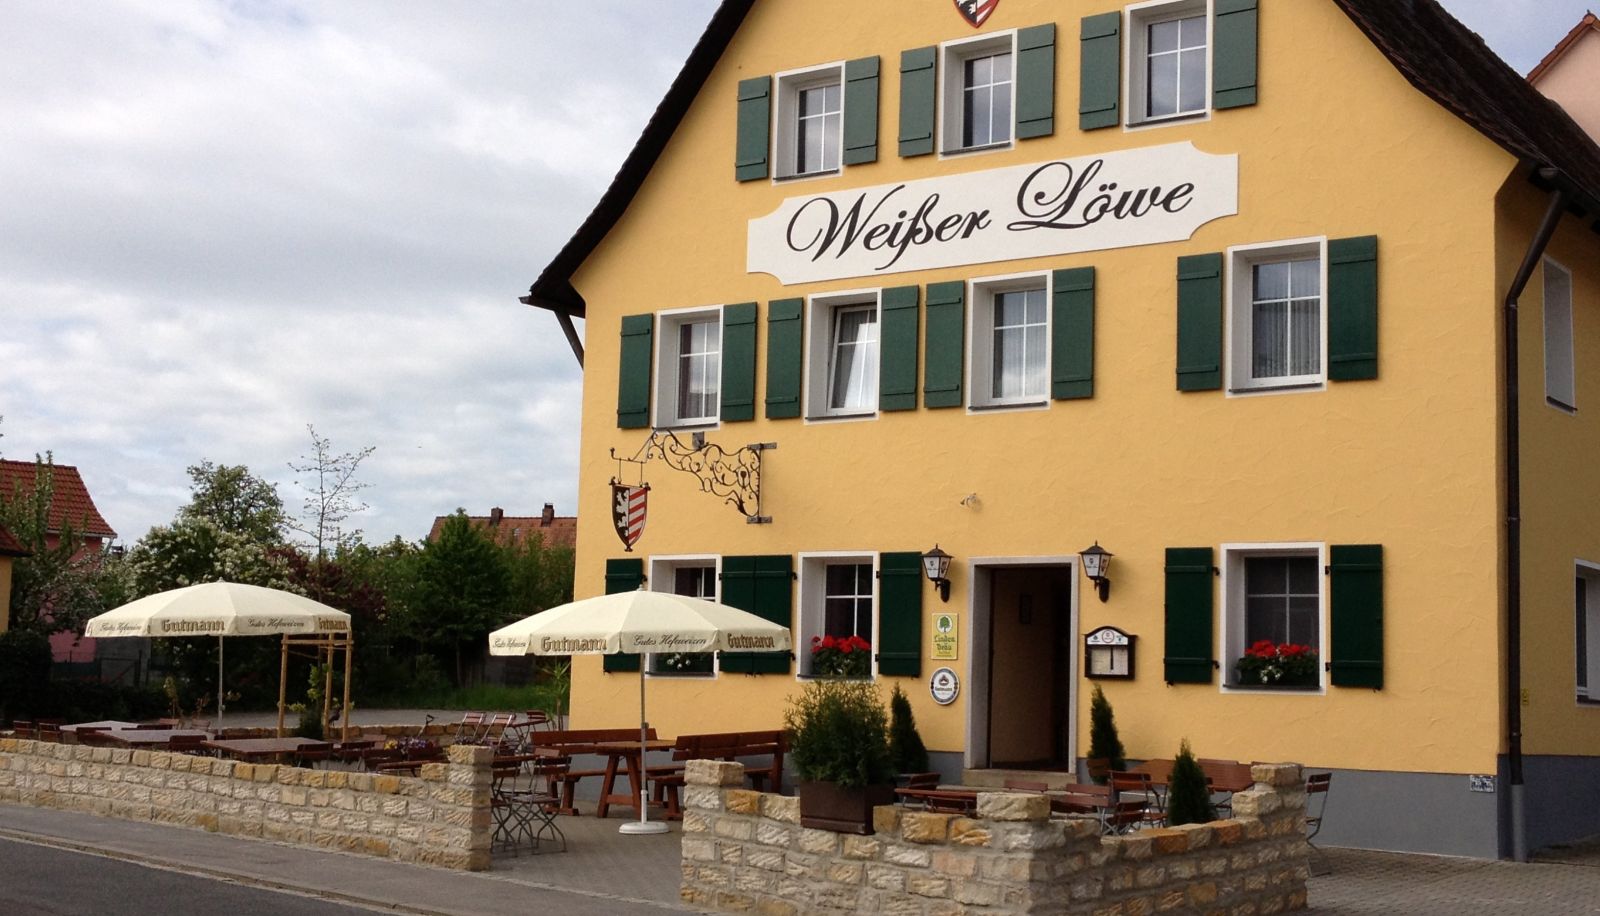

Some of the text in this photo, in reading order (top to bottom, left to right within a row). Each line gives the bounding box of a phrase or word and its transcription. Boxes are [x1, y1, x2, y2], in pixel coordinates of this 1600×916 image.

[786, 158, 1195, 271] Weißer Löwe
[160, 618, 226, 633] Gutmann
[540, 635, 608, 653] Gutmann
[632, 634, 657, 647] Gutes
[727, 632, 776, 649] Gutmann
